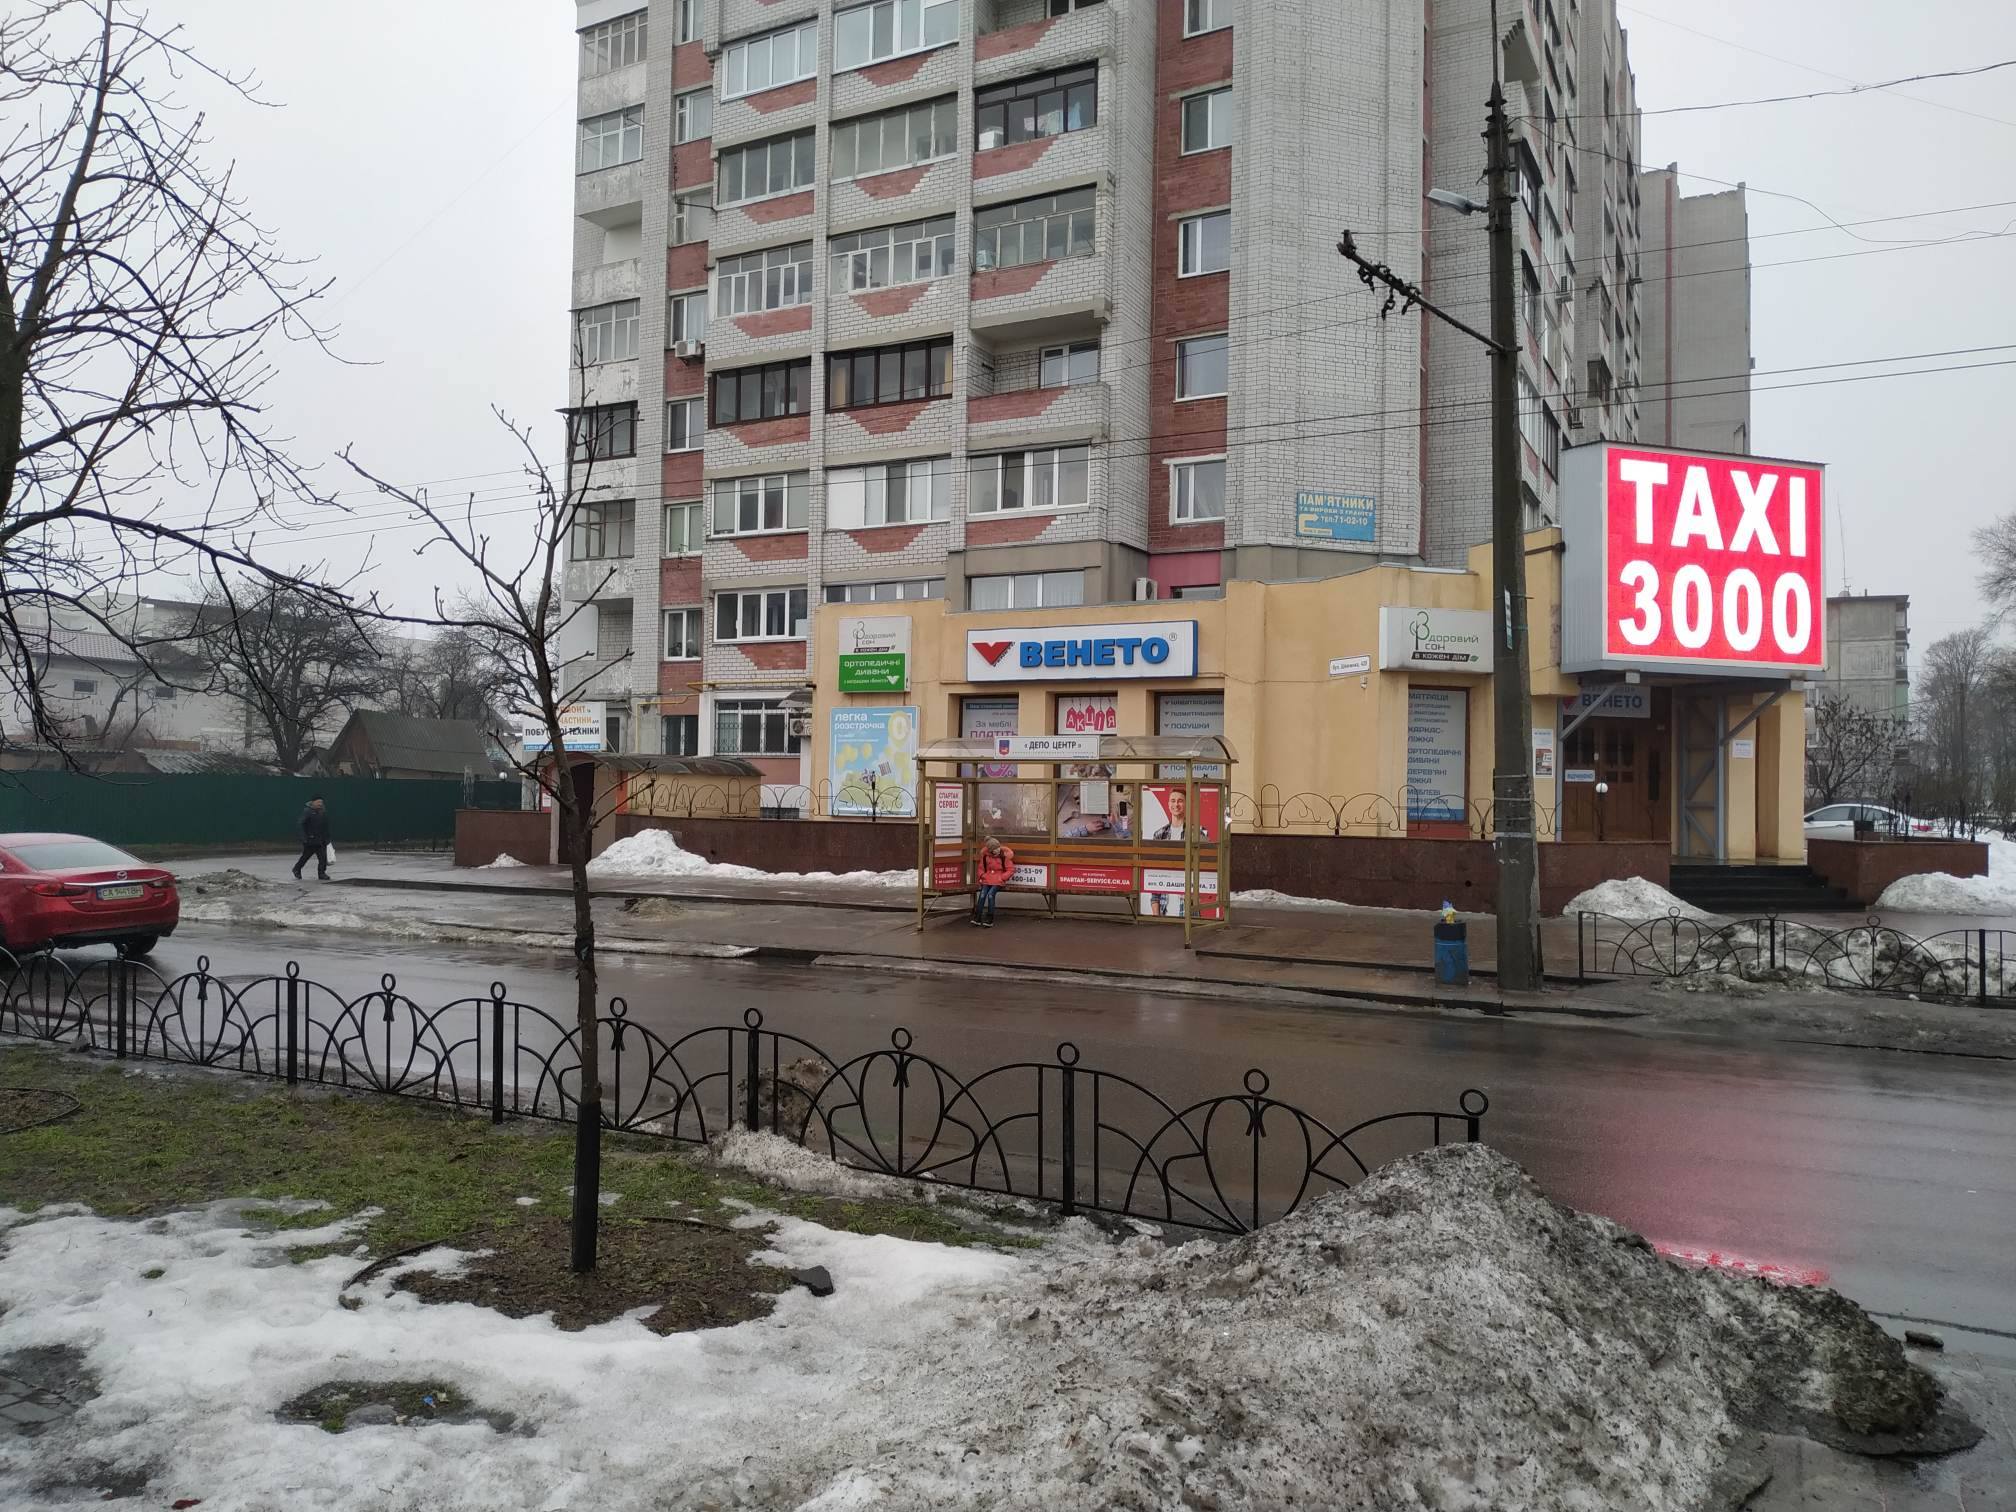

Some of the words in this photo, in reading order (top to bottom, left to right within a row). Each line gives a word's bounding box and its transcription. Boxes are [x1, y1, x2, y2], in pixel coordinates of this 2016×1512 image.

[1299, 493, 1374, 509] ПАМ'ЯТНИКИ
[1620, 458, 1806, 557] TAXI
[1619, 560, 1811, 654] 3000
[1020, 637, 1170, 668] ВЕНЕТО
[844, 659, 901, 669] ортопедичні
[835, 713, 868, 722] легка
[1067, 710, 1116, 732] АКЦІЯ
[1170, 764, 1218, 772] ПОКИВАЛА
